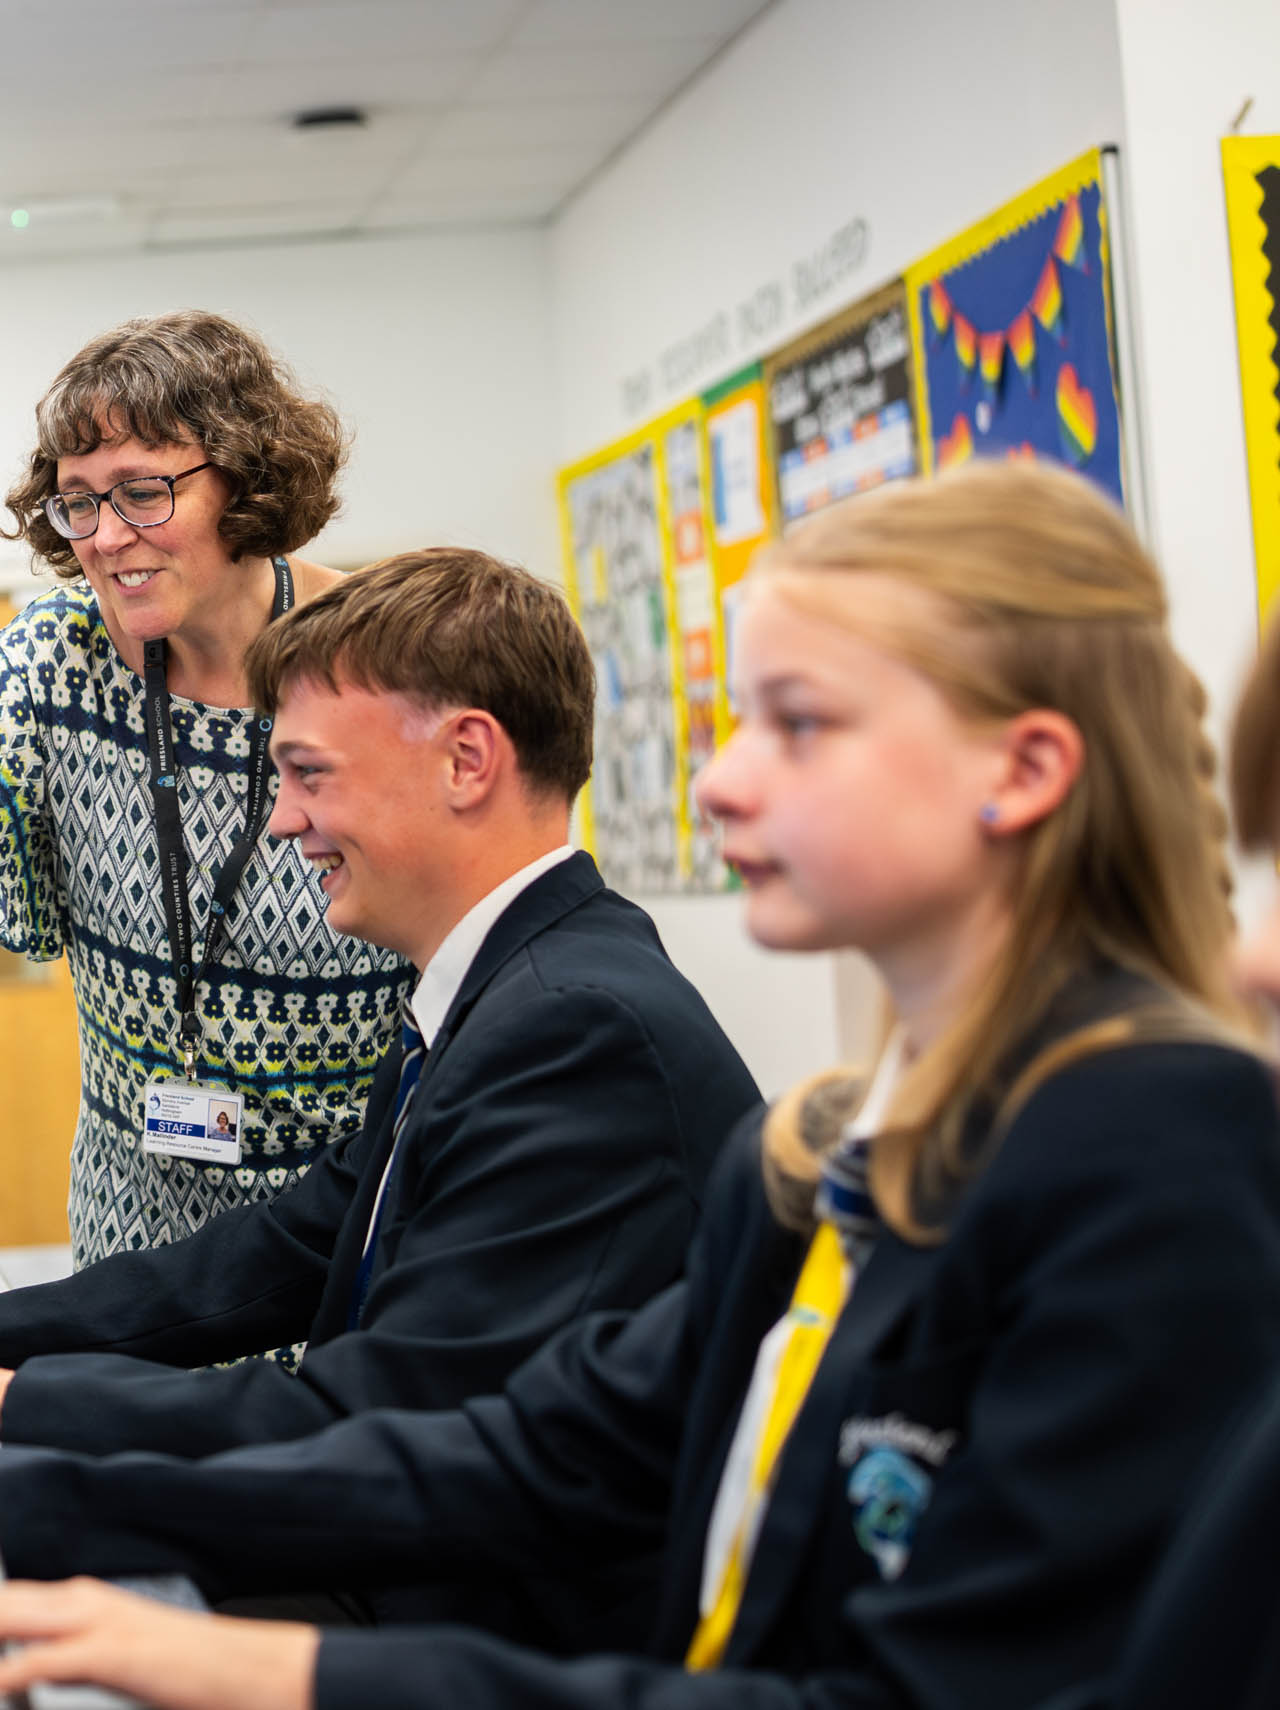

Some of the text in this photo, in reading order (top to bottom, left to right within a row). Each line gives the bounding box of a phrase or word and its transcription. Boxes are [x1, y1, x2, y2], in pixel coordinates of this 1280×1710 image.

[154, 696, 167, 771] FRIESLAND SCHOOL
[257, 737, 266, 752] THE
[256, 755, 264, 773] TWO
[169, 852, 178, 876] TRUST
[172, 880, 182, 919] COUNTIES
[158, 1121, 193, 1135] STAFF
